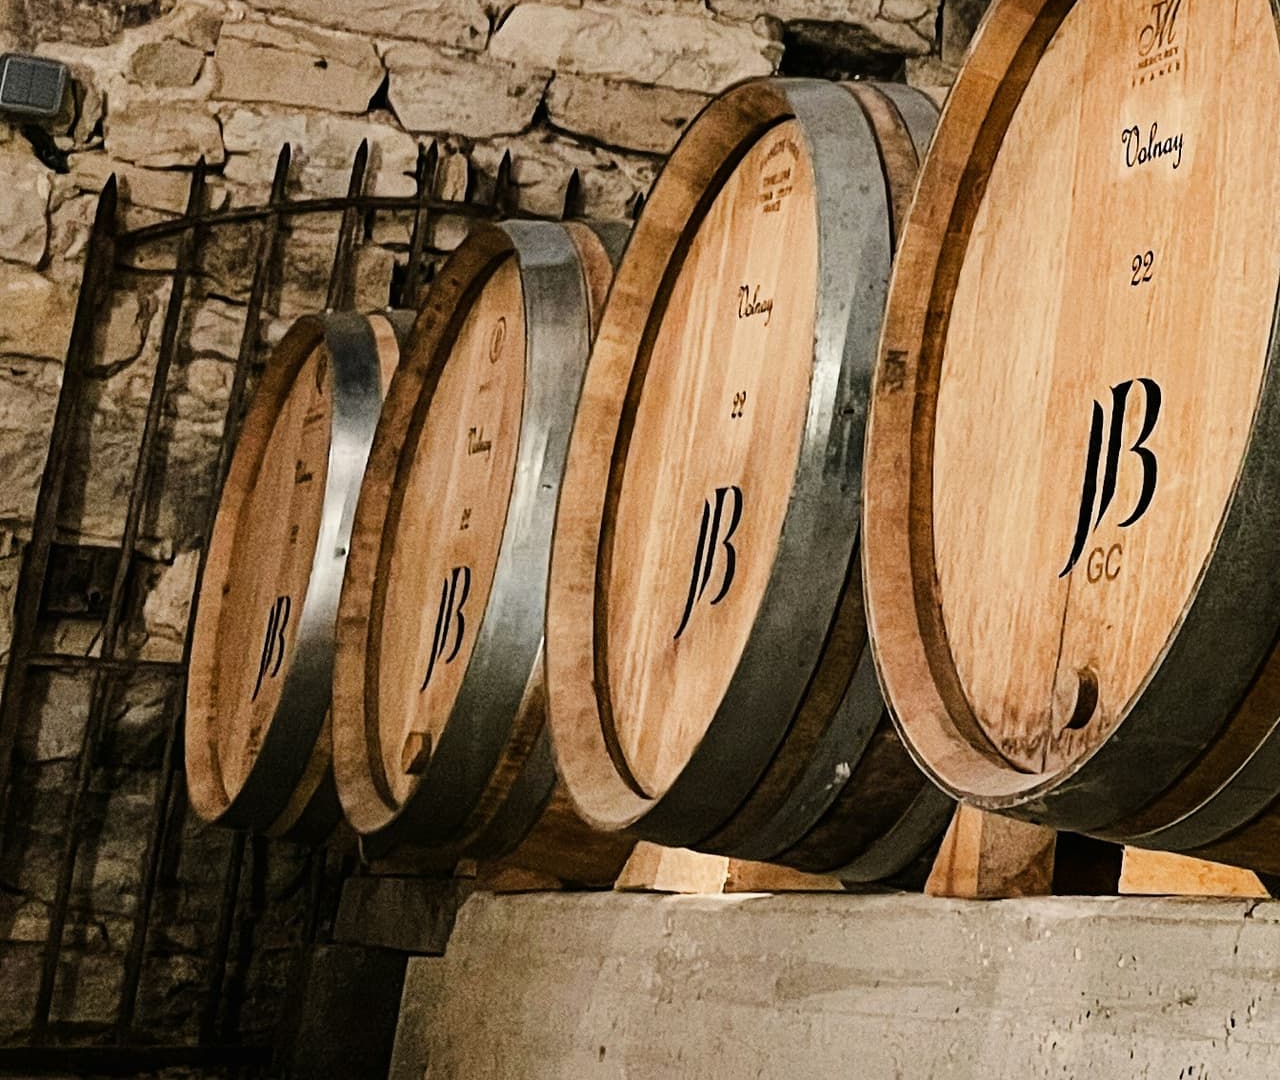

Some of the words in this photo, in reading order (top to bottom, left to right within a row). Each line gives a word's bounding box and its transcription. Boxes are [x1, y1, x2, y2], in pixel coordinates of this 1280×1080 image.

[1121, 121, 1184, 170] Volnay
[1130, 250, 1154, 287] 22
[1059, 378, 1162, 579] JB
[673, 485, 743, 640] JB
[1087, 543, 1124, 585] GC
[420, 565, 471, 694] JB
